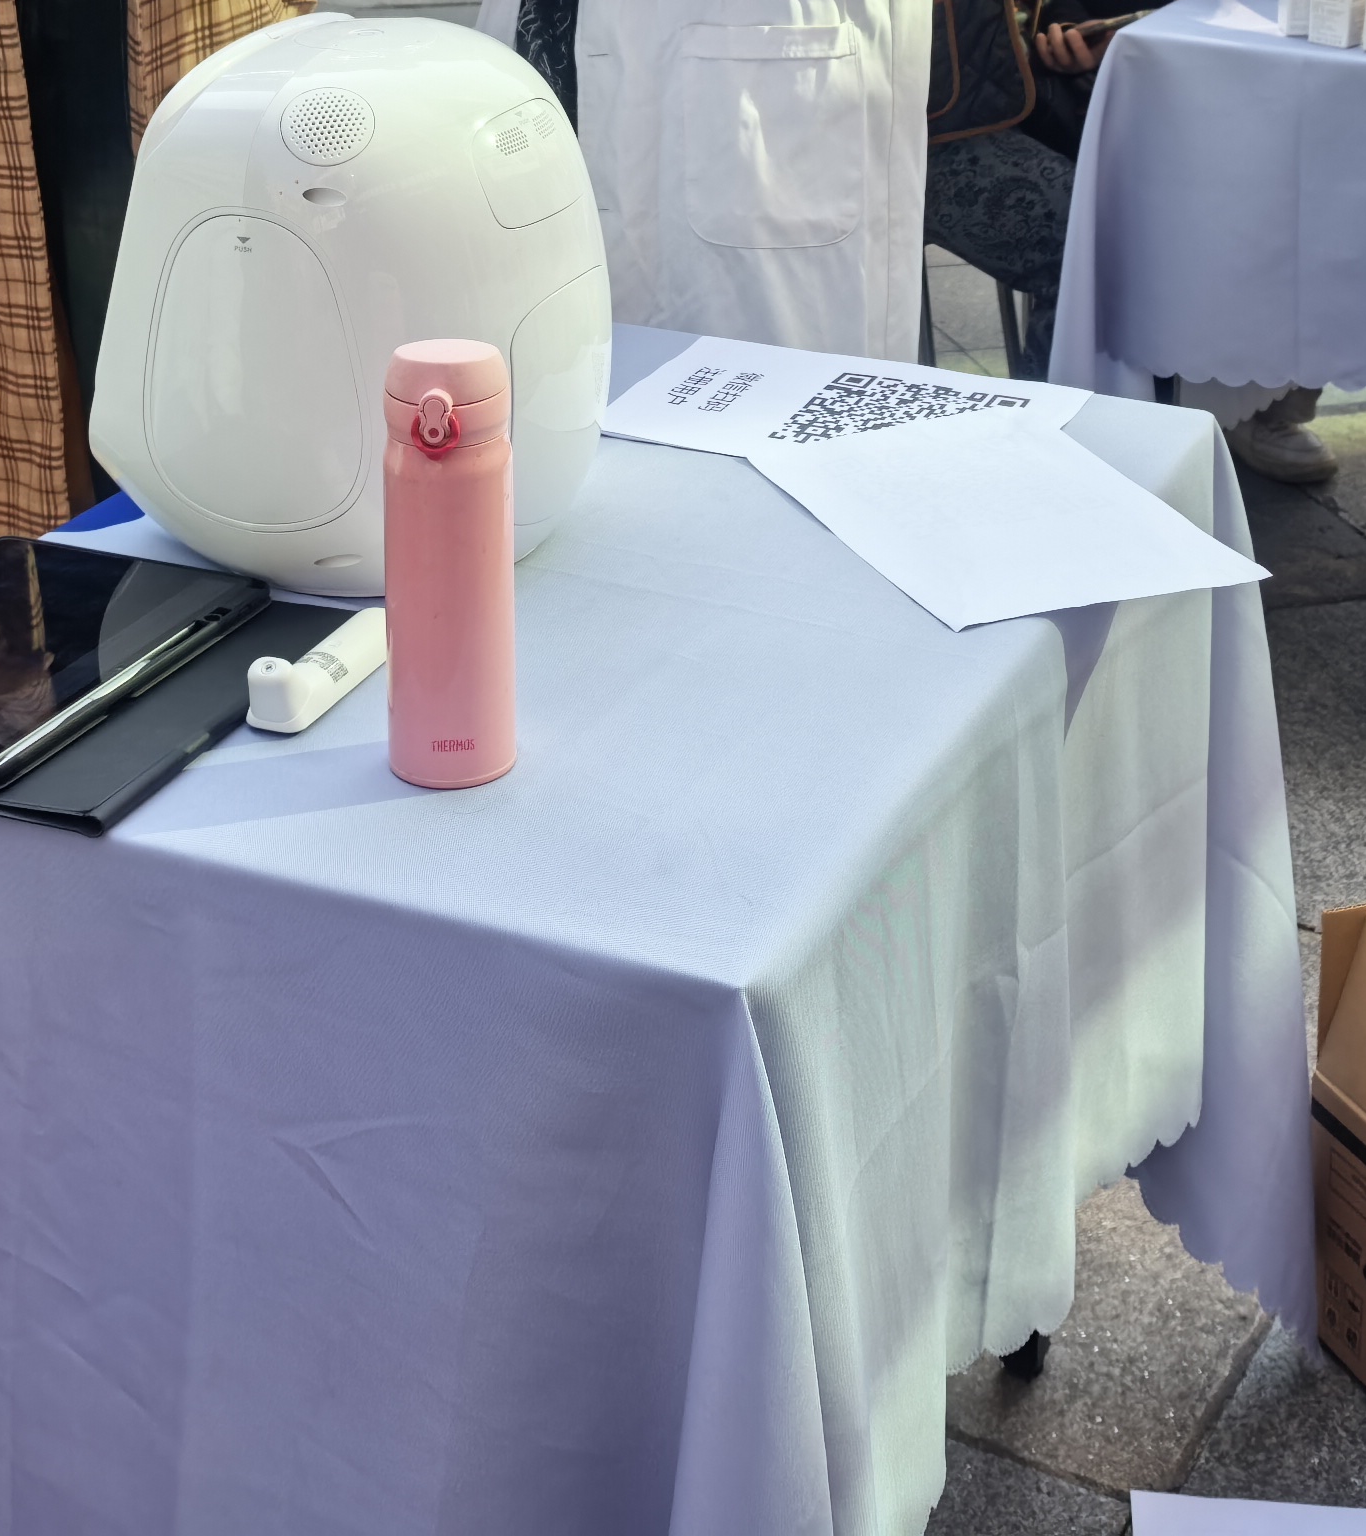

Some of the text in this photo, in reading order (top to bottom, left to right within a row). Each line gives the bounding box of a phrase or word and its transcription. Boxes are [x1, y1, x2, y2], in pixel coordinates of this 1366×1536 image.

[234, 245, 253, 254] PUSH
[667, 366, 728, 406] 注册用户
[697, 372, 765, 412] 微信扫码
[431, 738, 475, 753] THERMOS
